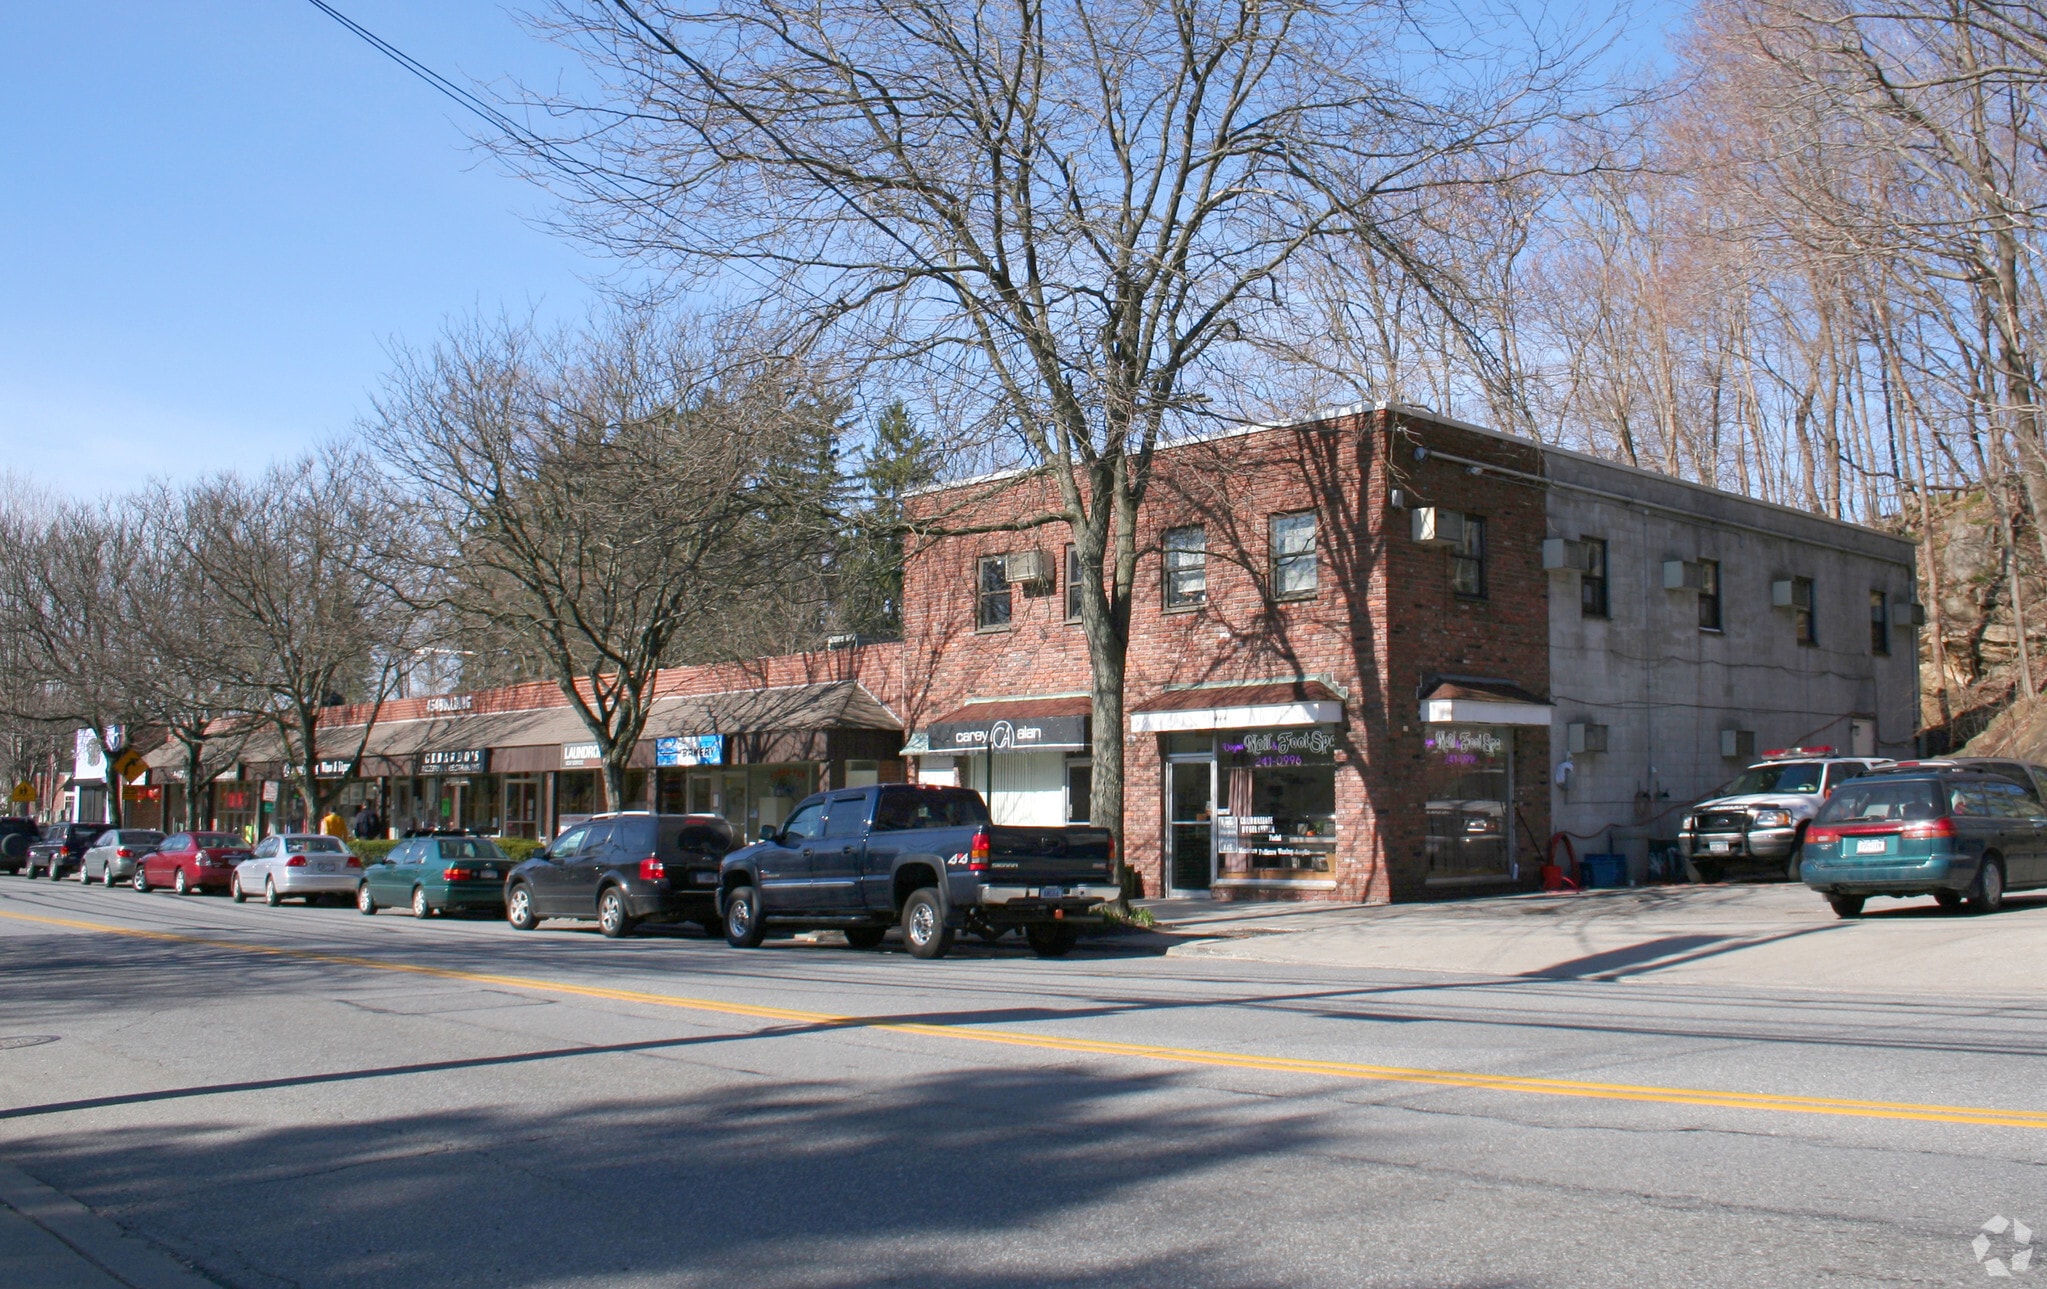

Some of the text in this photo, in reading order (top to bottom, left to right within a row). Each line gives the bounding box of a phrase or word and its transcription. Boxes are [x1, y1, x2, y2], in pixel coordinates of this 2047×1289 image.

[955, 730, 989, 744] carey
[1017, 725, 1042, 741] alan
[1243, 733, 1272, 755] Nail
[1277, 731, 1310, 754] Foot
[424, 750, 480, 764] GERARDO'S
[564, 745, 601, 760] LAUNDRO
[681, 747, 715, 758] BAKERY
[1255, 754, 1303, 767] 241-0996
